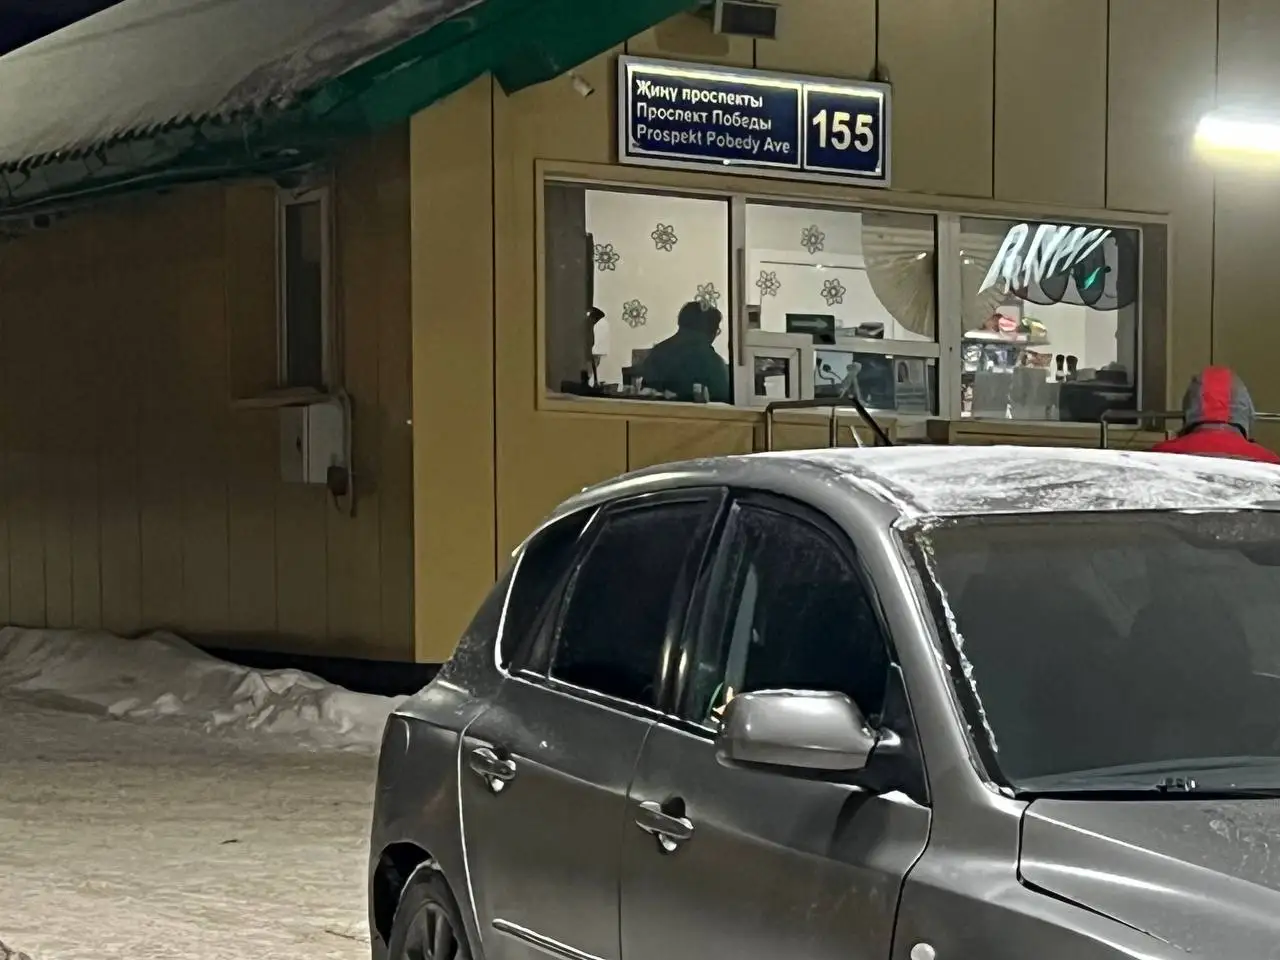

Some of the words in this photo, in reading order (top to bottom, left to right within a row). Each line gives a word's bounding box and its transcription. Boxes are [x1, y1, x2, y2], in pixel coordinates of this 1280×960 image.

[682, 87, 763, 108] проспекты
[636, 102, 708, 123] Проспект
[712, 110, 772, 131] Победы
[812, 109, 874, 153] 155
[636, 124, 702, 146] Prospekt
[707, 131, 760, 154] Pobedy
[764, 137, 791, 154] Ave
